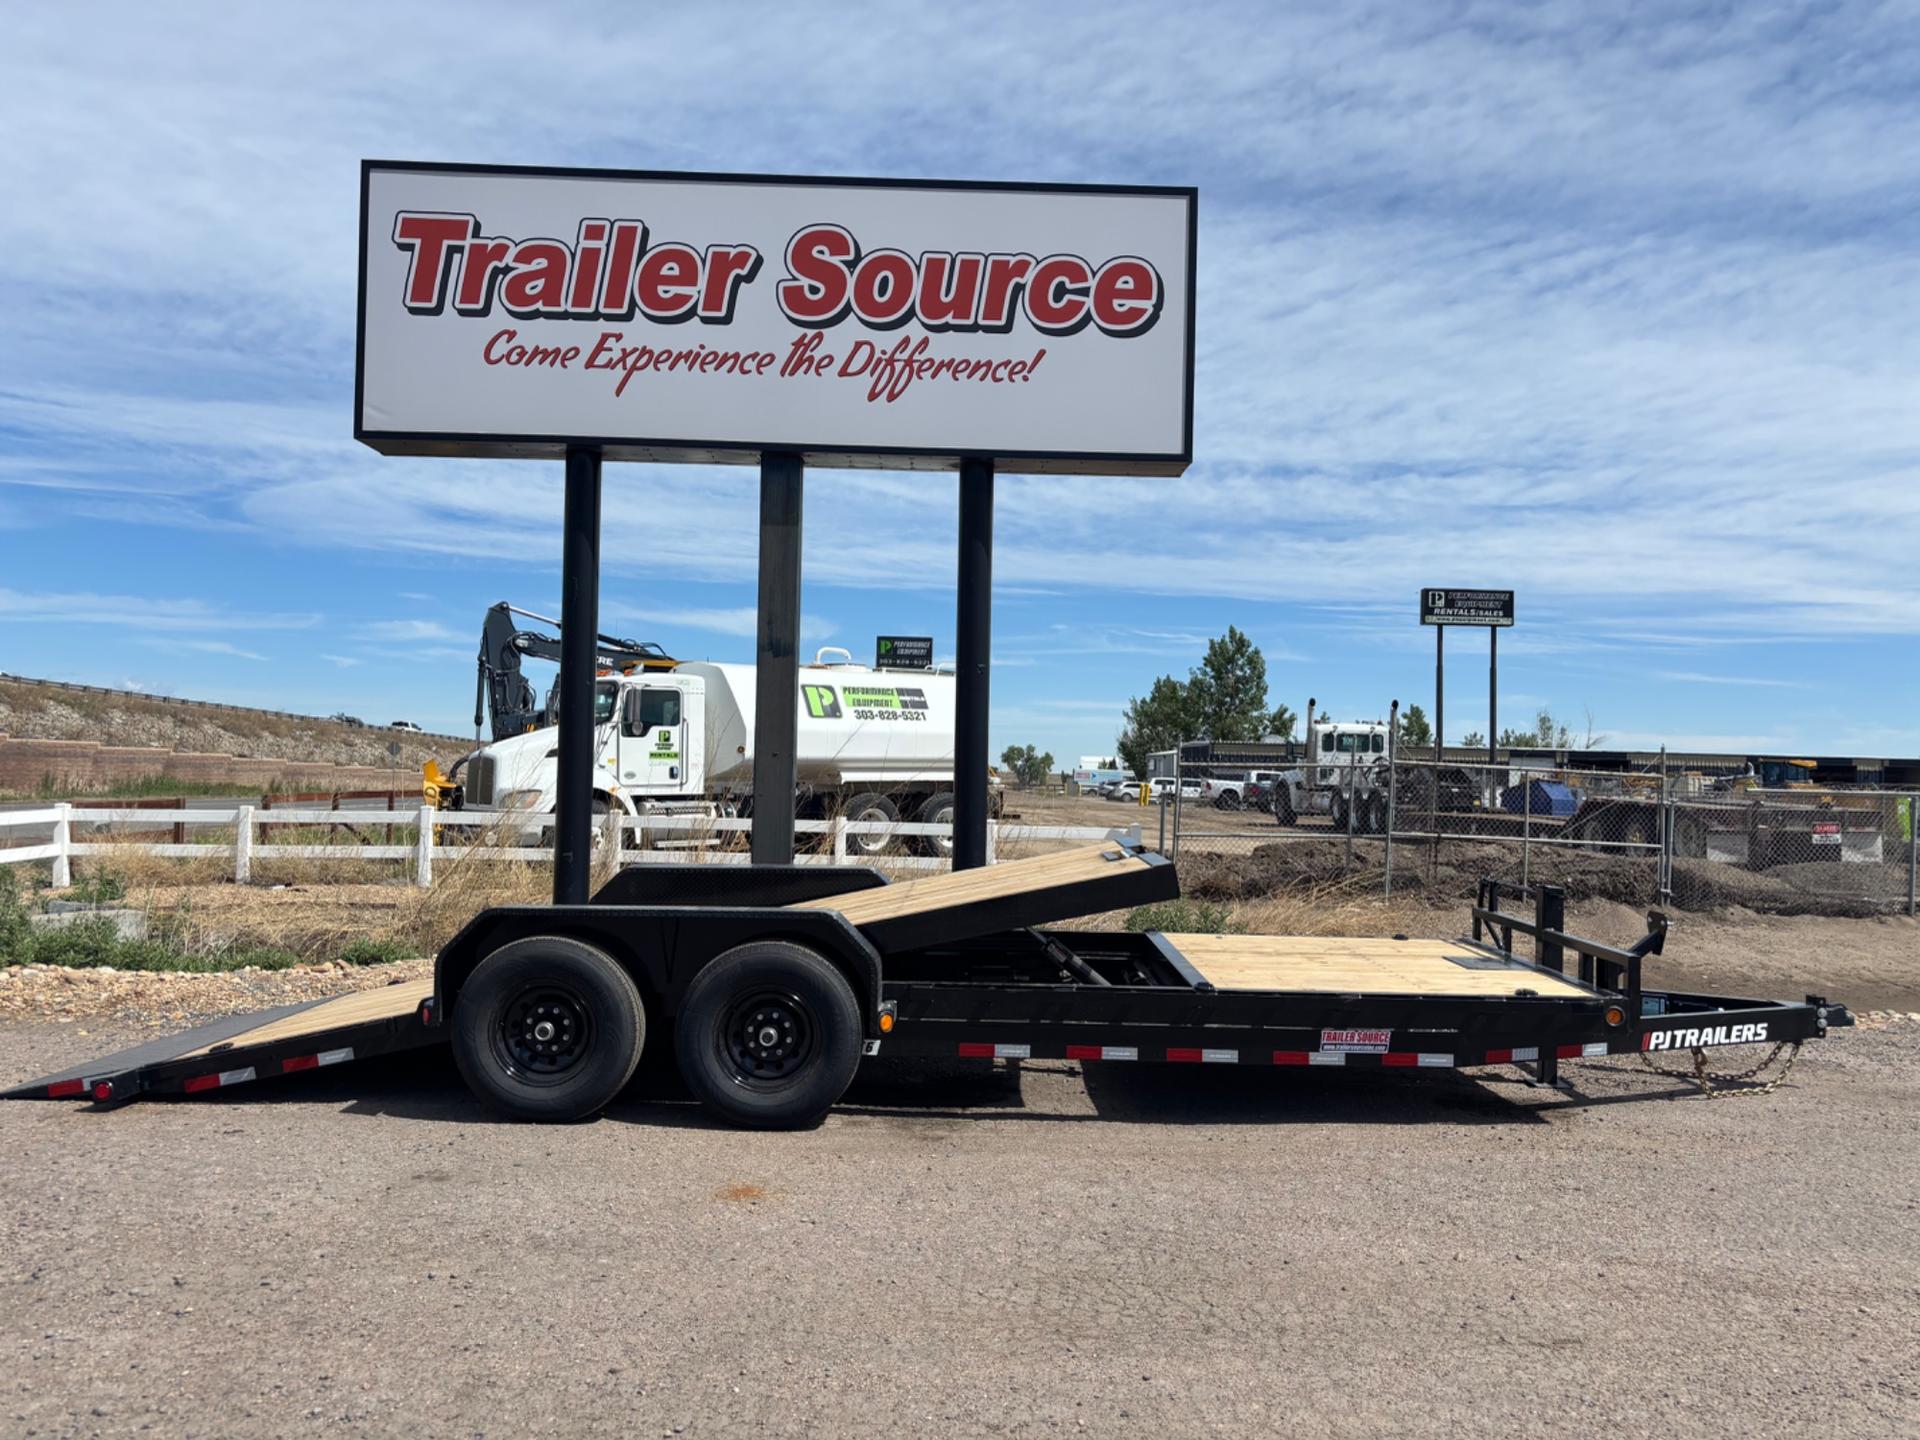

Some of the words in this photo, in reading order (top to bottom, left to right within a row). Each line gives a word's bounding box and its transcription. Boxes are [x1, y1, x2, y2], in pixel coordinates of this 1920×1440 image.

[392, 210, 764, 325] Trailer
[777, 223, 1164, 338] Source
[483, 329, 581, 368] Come
[584, 332, 776, 398] Experience
[779, 331, 834, 377] the
[837, 336, 1047, 403] Difference!
[842, 686, 895, 696] PERFORMANCE
[852, 698, 893, 707] EQUIPMENT
[854, 709, 927, 721] 303-828-5321
[1323, 1031, 1356, 1042] TRAILER
[1357, 1031, 1389, 1042] SOURCE
[1649, 1031, 1672, 1050] PJ
[1674, 1023, 1768, 1048] TRAILERS
